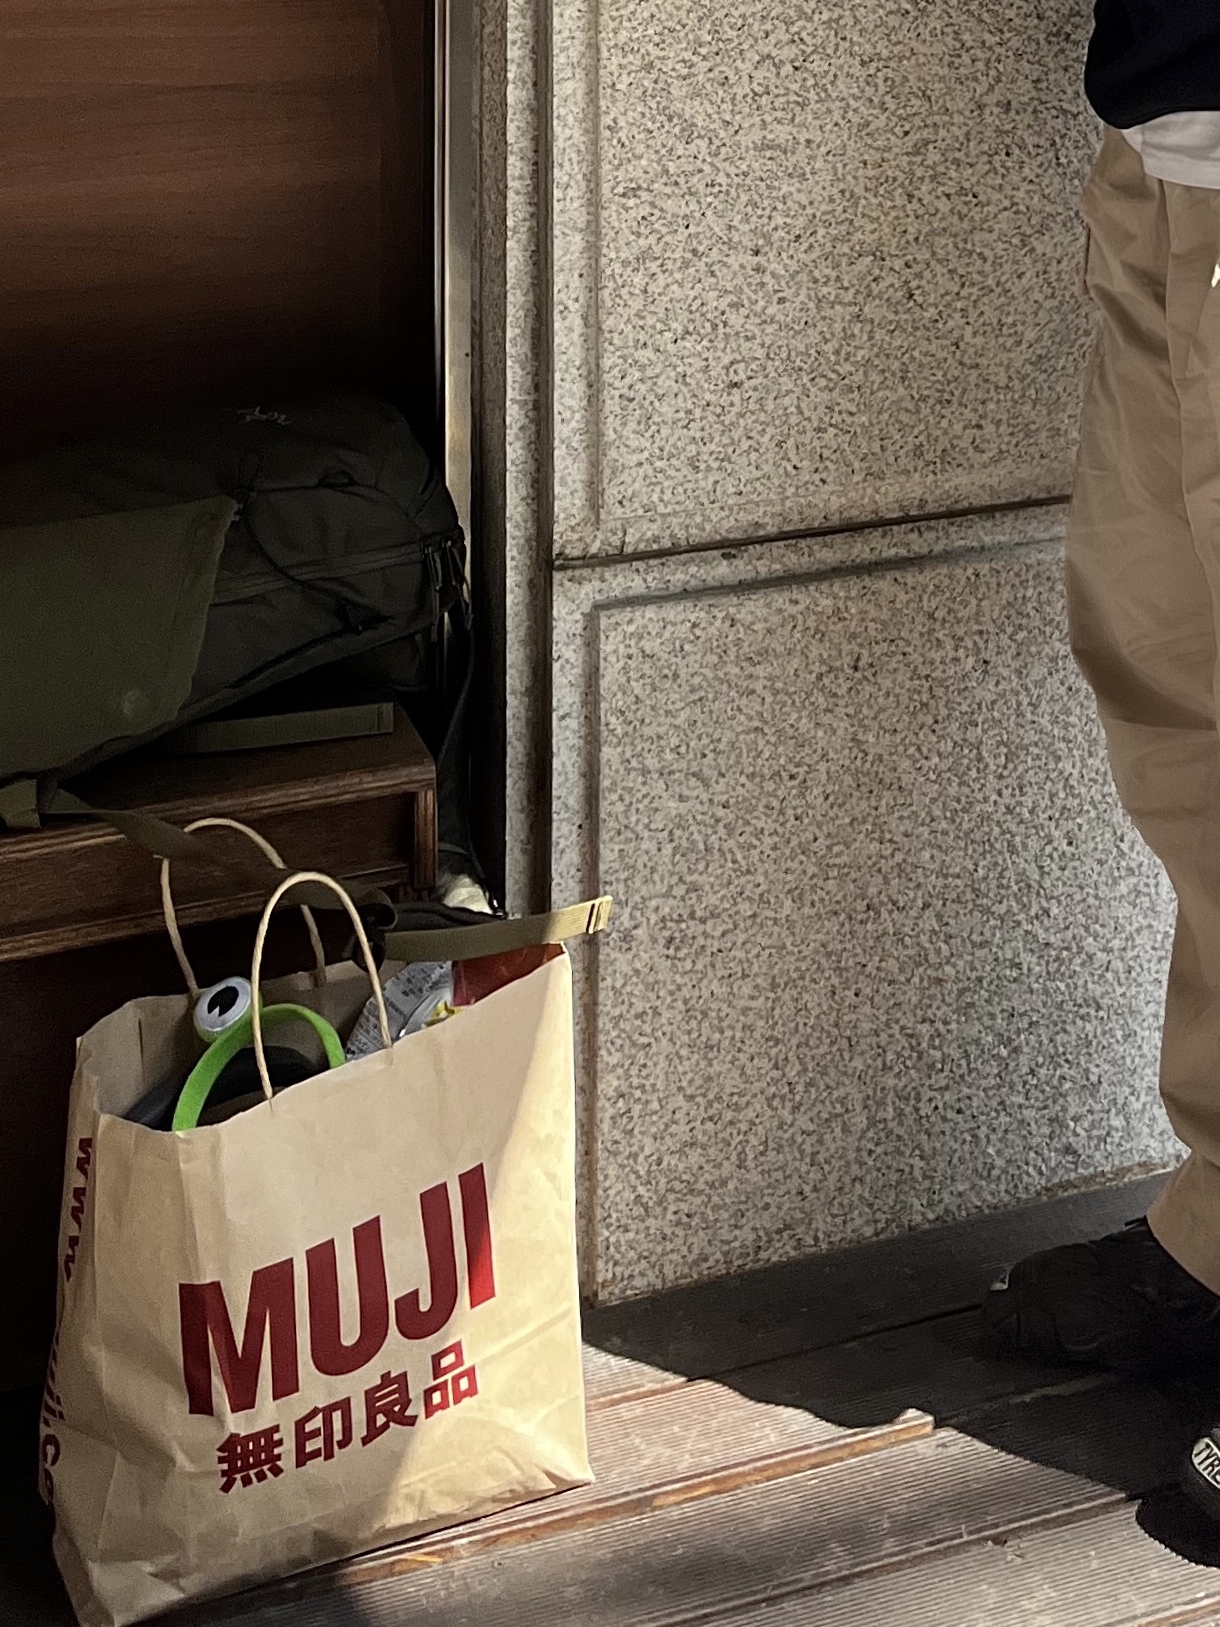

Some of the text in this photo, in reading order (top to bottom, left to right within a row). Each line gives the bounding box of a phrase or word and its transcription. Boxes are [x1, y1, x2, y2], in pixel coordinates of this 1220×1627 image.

[179, 1162, 496, 1416] MUJI
[216, 1339, 478, 1494] 無印良品
